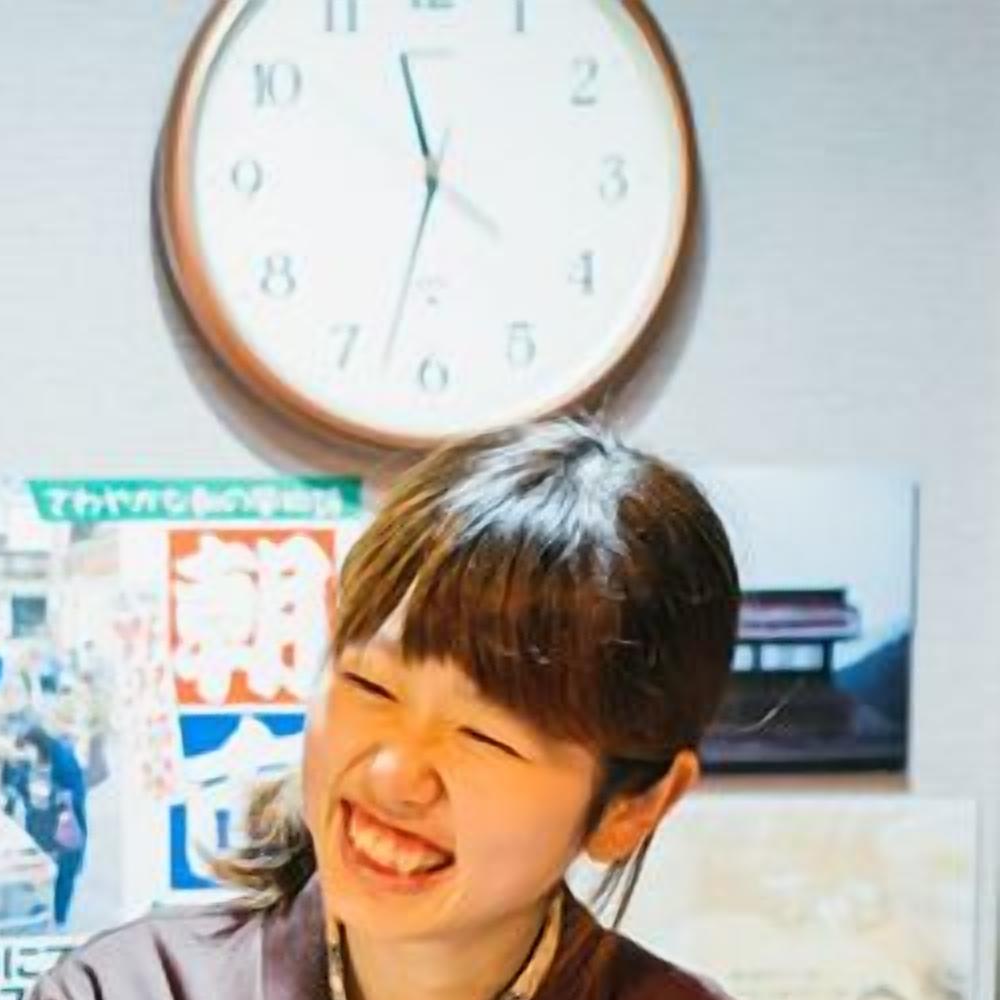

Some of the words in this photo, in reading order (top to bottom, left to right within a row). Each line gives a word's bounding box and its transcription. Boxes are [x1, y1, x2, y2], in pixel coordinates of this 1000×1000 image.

[253, 62, 302, 108] 10
[571, 58, 599, 106] 2
[230, 159, 264, 195] 9
[600, 155, 629, 200] 3
[258, 254, 297, 297] 8
[569, 250, 595, 296] 4
[331, 323, 361, 370] 7
[505, 320, 537, 367] 5
[417, 355, 450, 395] 6
